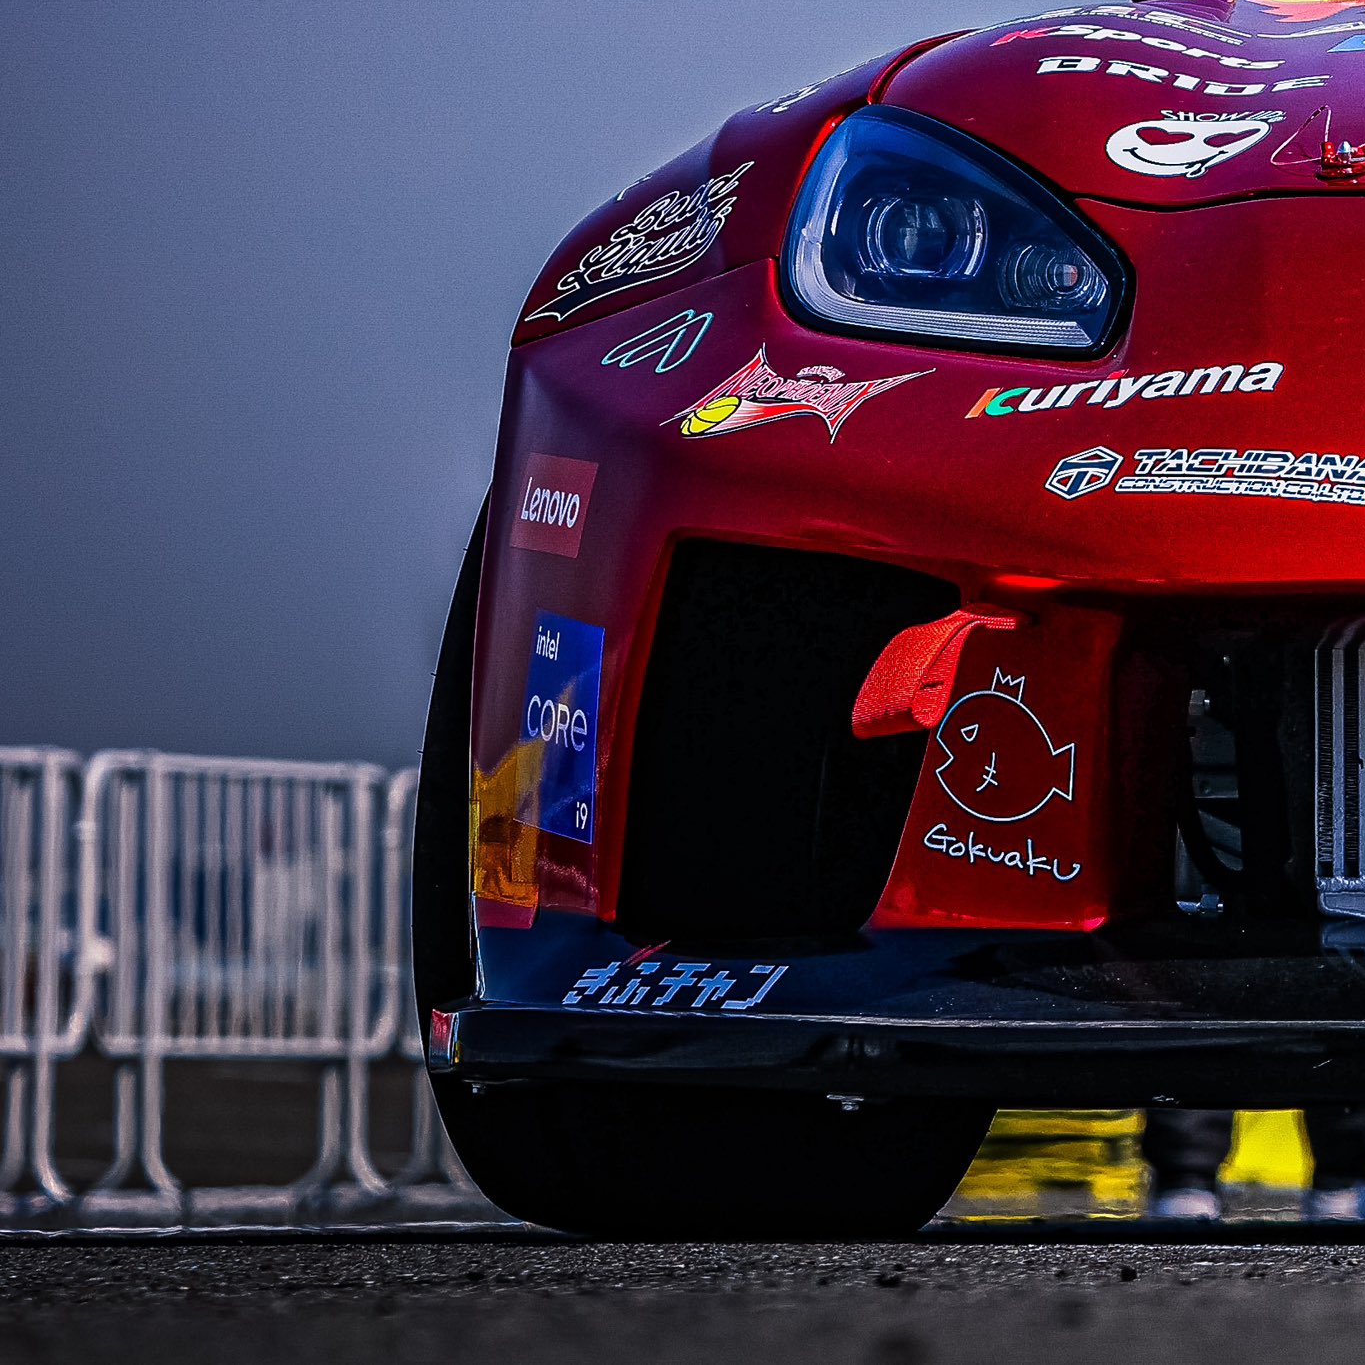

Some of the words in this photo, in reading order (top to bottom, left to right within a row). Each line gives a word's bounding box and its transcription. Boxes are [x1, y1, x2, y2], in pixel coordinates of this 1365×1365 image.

[1036, 56, 1334, 96] BRIDE
[520, 476, 582, 529] Lenovo
[1114, 476, 1282, 495] CONSTRUCTION
[534, 625, 560, 662] intel
[574, 800, 589, 831] i9
[923, 823, 1081, 881] Gokuaku
